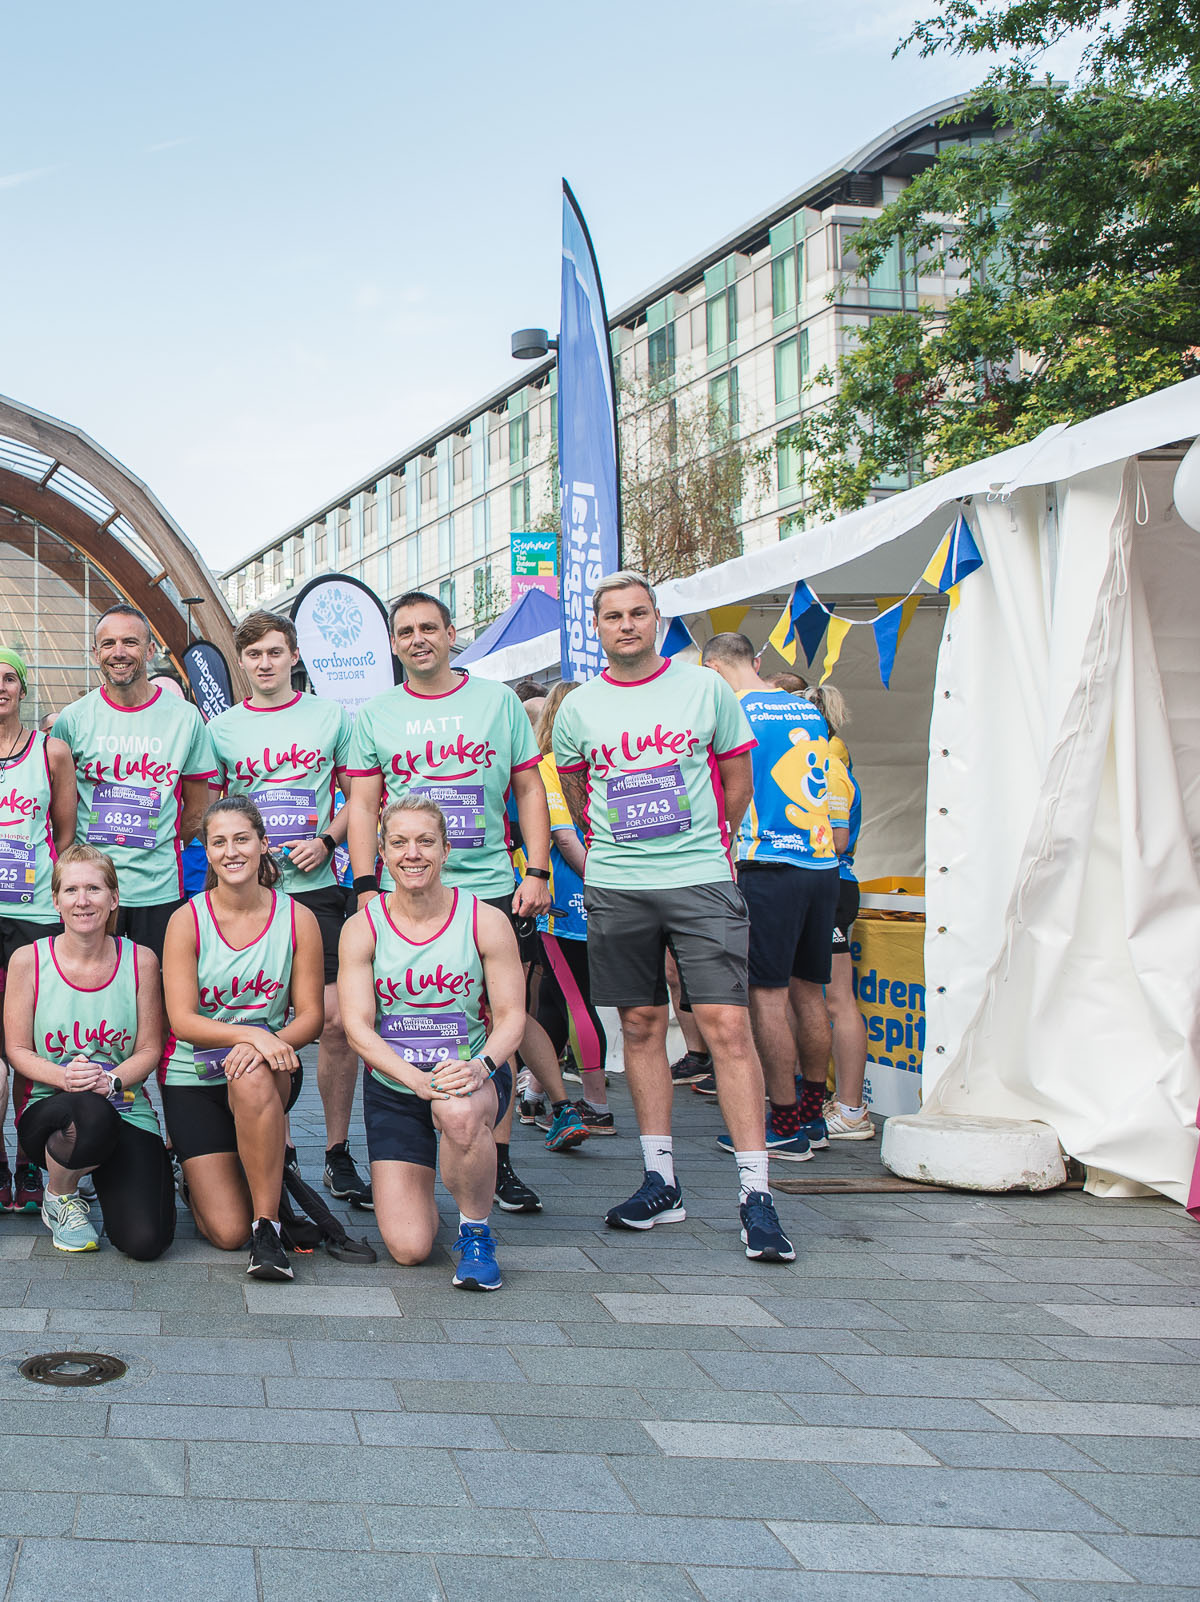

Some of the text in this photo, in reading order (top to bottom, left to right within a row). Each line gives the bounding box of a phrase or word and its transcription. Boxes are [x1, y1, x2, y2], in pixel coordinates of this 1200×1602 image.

[513, 539, 554, 553] Summer
[405, 715, 464, 735] MATT
[750, 712, 783, 722] Follow
[95, 736, 162, 754] TOMMO
[591, 724, 700, 778] St Luke's
[235, 743, 326, 787] St Luke's
[391, 734, 496, 784] St Luke's
[114, 753, 179, 787] Luke's
[626, 799, 671, 819] 5743
[104, 812, 142, 827] 6832
[262, 814, 306, 827] 10078
[626, 813, 675, 828] FOR YOU BRO
[5, 833, 30, 841] Hospice
[110, 826, 133, 834] TOMMO
[375, 964, 475, 1007] St Luke's
[200, 986, 228, 1013] St
[420, 1023, 458, 1031] MARATHON
[45, 1019, 131, 1058] St Luke's
[403, 1047, 450, 1063] 8179
